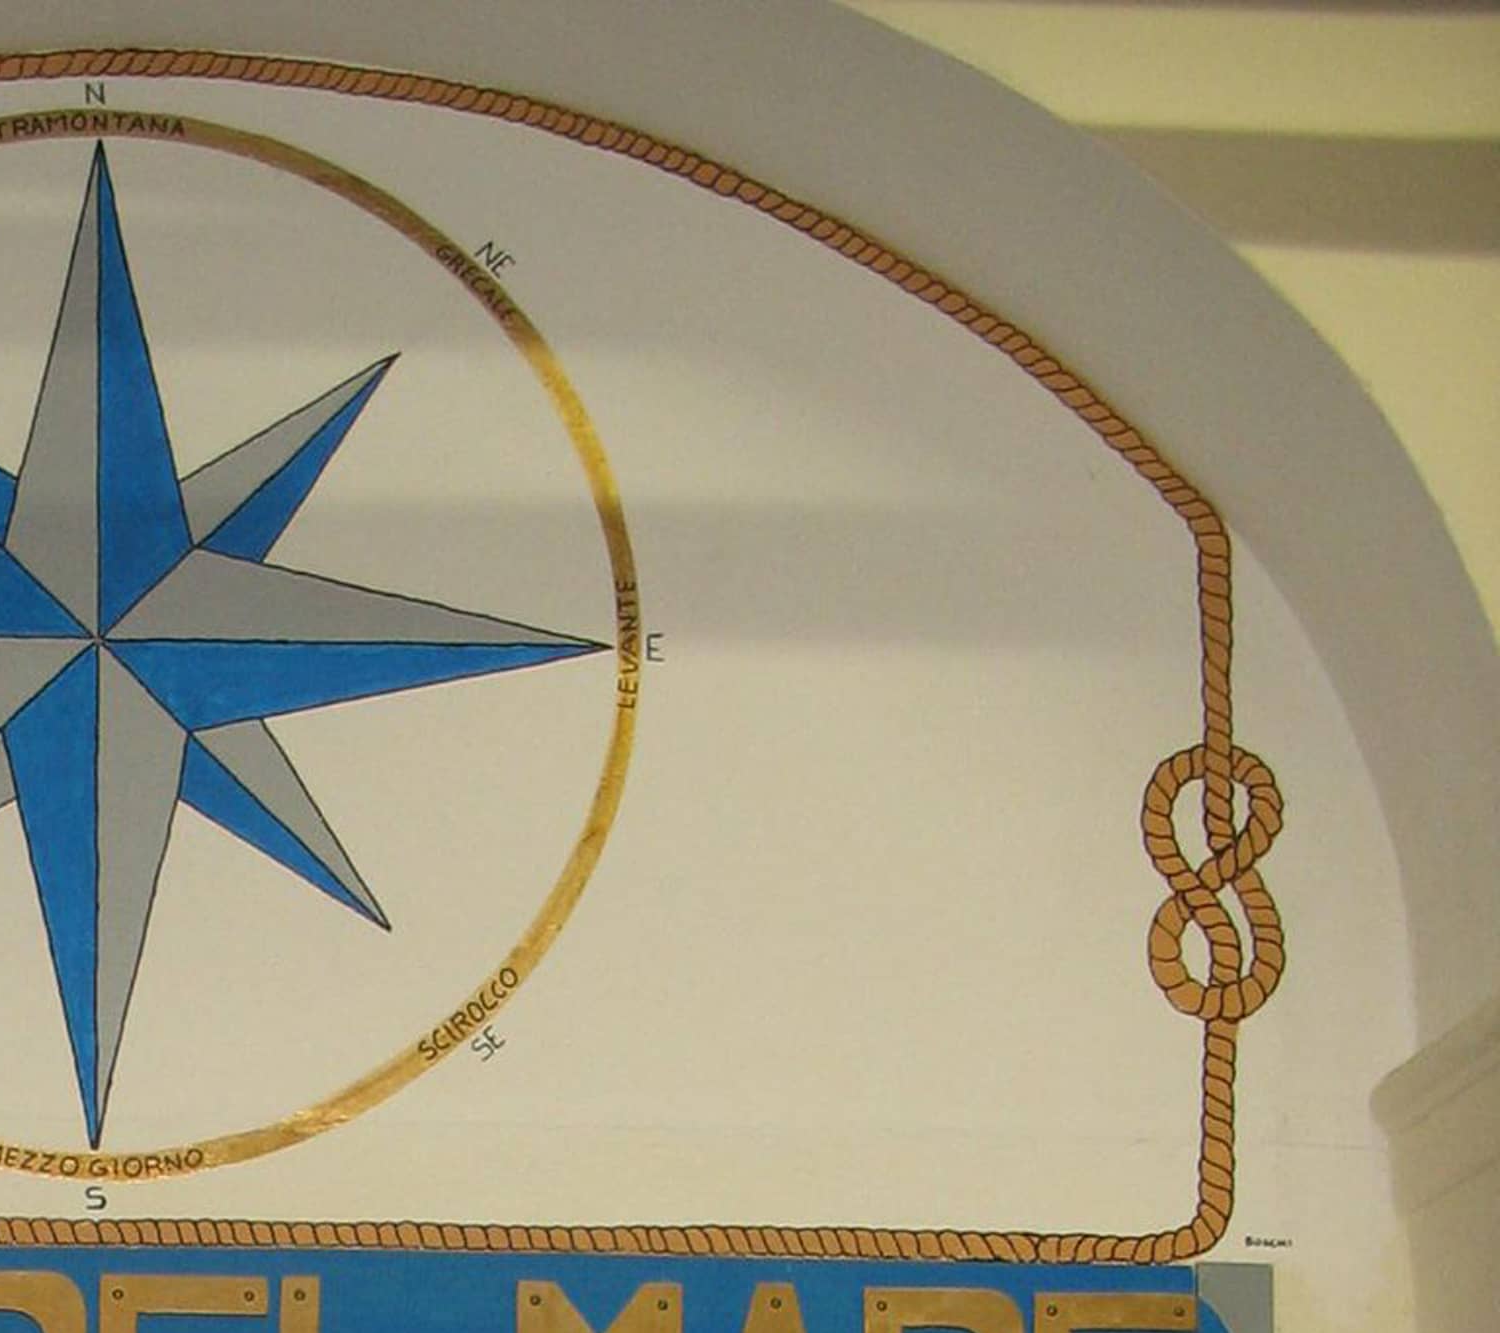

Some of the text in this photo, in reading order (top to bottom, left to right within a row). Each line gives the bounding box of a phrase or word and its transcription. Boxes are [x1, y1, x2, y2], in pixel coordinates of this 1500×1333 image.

[85, 83, 106, 105] N
[474, 241, 516, 279] NE
[436, 245, 517, 322] GRECALE
[615, 581, 639, 708] LEVANTE
[646, 633, 665, 661] E
[417, 967, 519, 1061] SCIROCCO
[470, 1025, 506, 1062] SE
[85, 1186, 107, 1210] S
